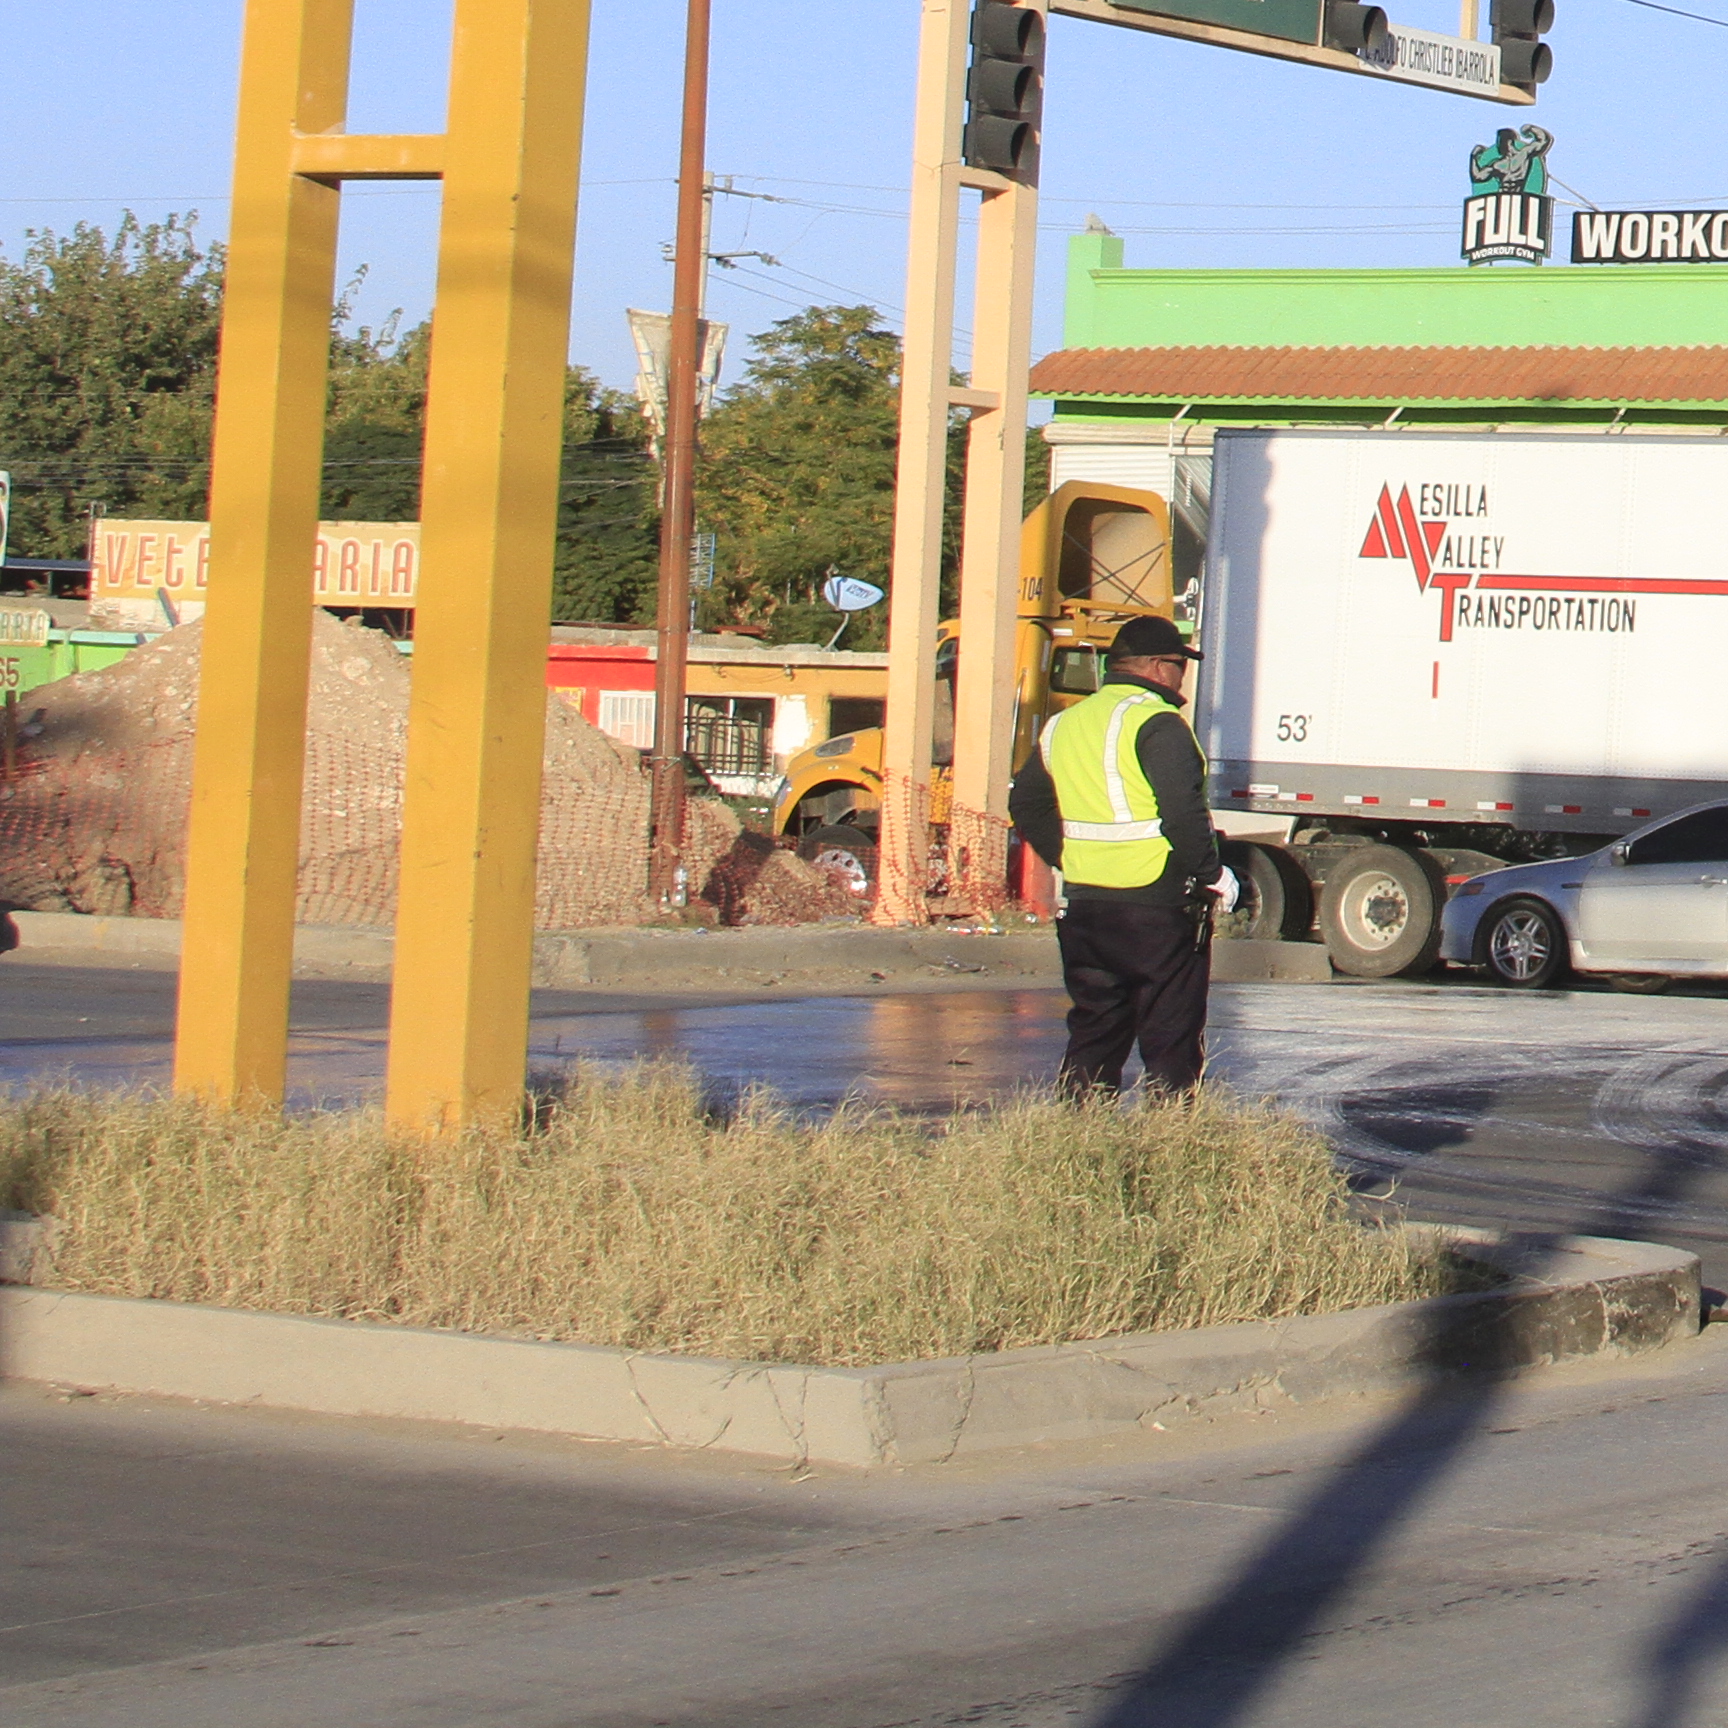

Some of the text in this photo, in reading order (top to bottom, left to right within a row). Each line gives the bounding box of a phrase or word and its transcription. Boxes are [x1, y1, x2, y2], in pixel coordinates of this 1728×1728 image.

[1465, 194, 1545, 251] FULL
[1471, 246, 1535, 260] WORKOUT GYM
[1429, 573, 1636, 642] TRANSPORTATION
[1276, 714, 1312, 742] 53'
